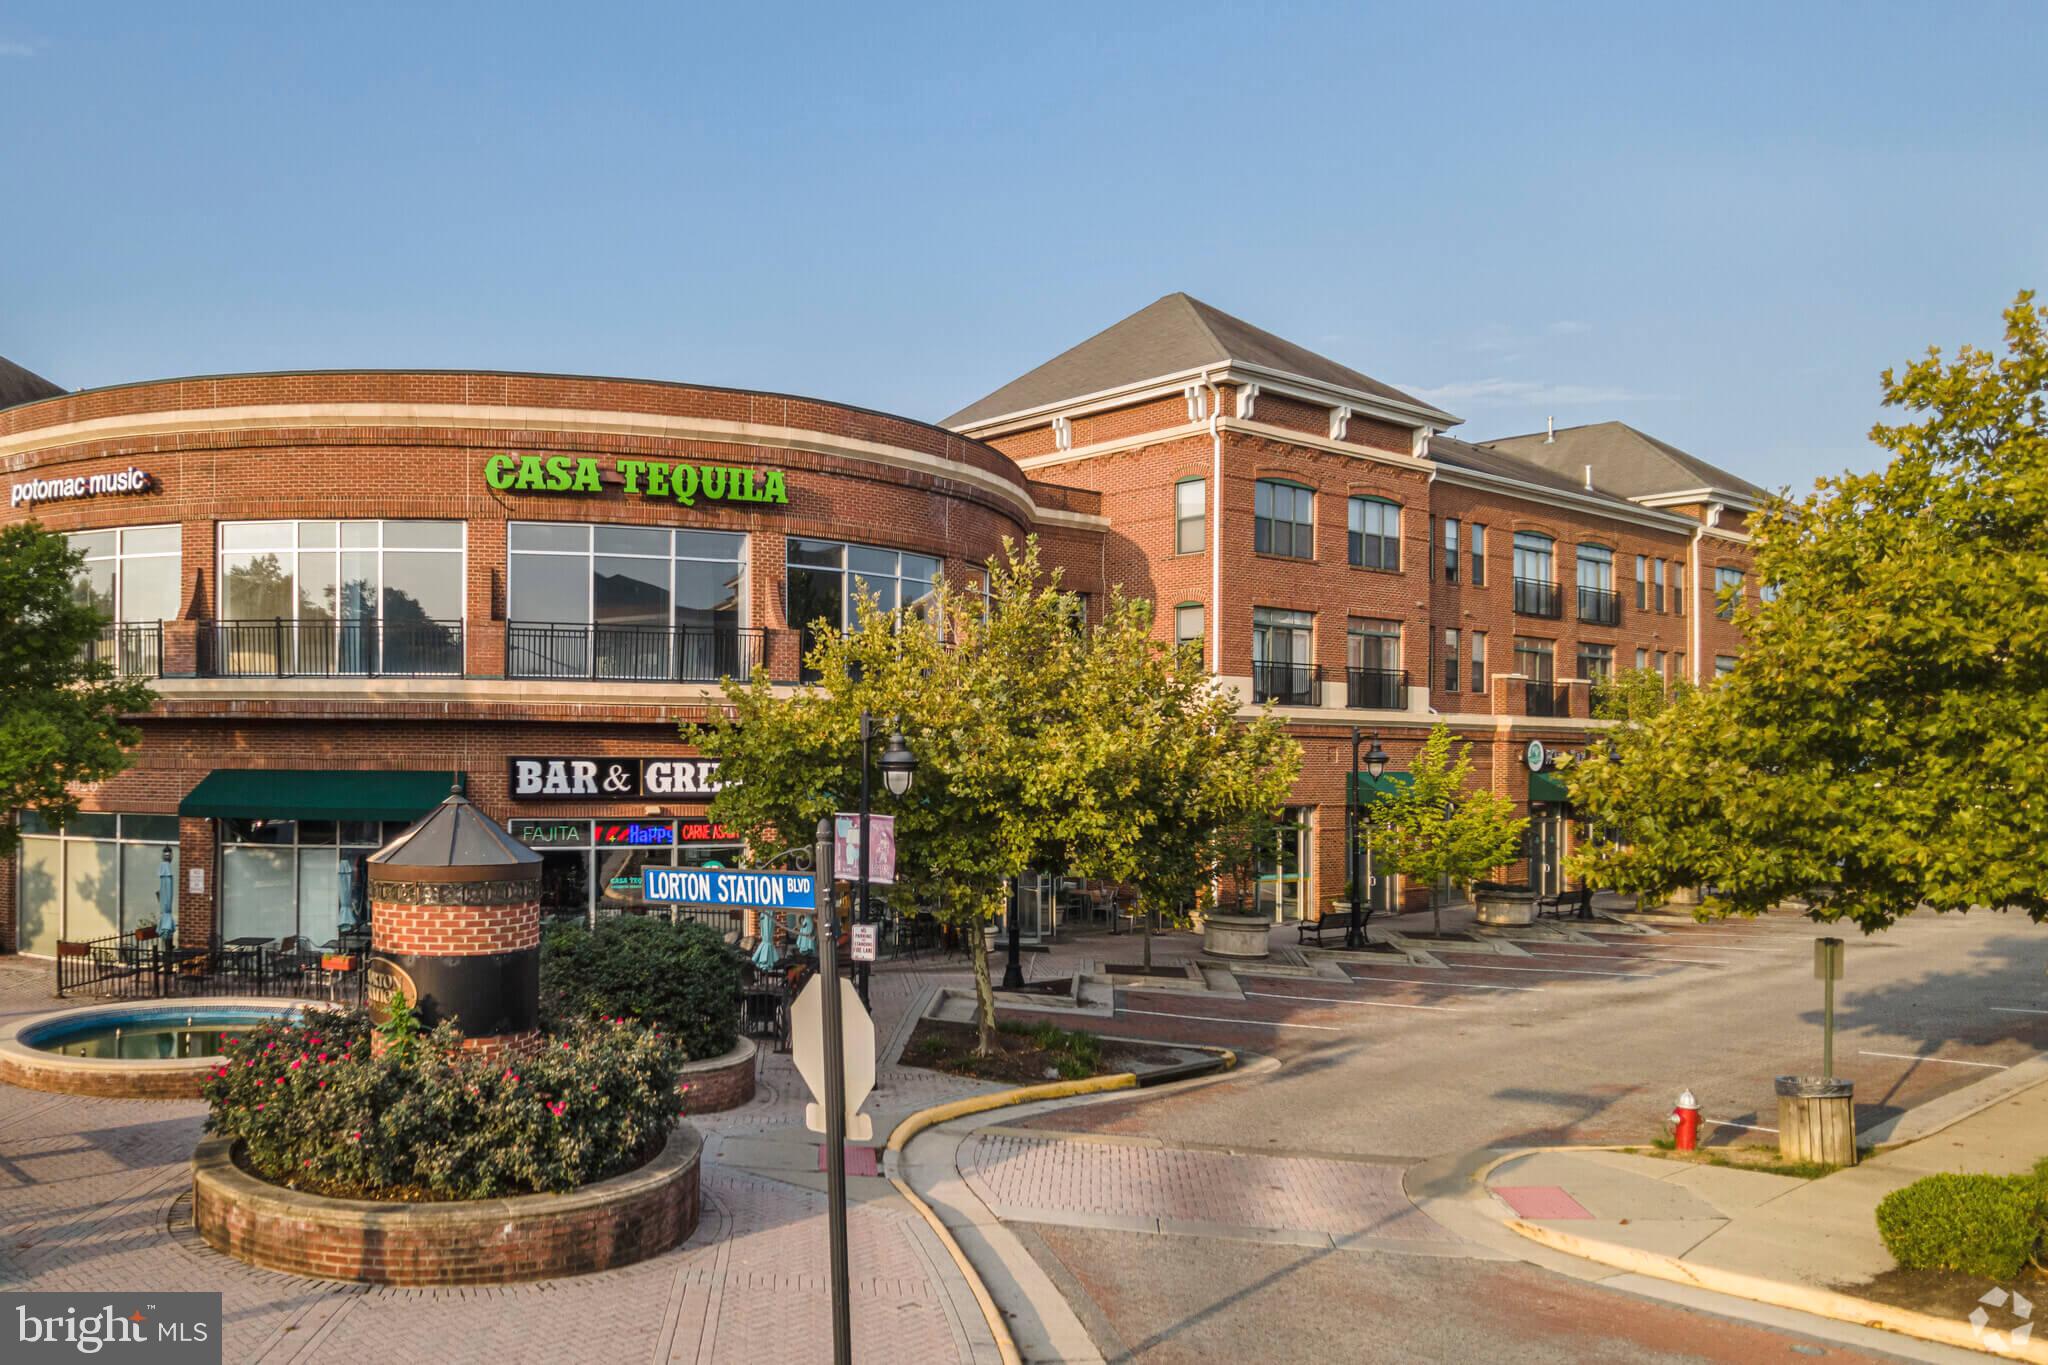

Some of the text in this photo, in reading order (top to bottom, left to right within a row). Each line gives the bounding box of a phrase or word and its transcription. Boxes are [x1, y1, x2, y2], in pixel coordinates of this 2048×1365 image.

[11, 466, 144, 507] potomac music
[484, 454, 788, 506] CASA TEQUILA
[516, 760, 599, 794] BAR
[603, 764, 632, 792] &
[523, 826, 580, 841] FAJITA
[629, 824, 673, 844] Happy
[682, 824, 711, 840] CARNE
[649, 871, 811, 905] LORTON STATION BLVD
